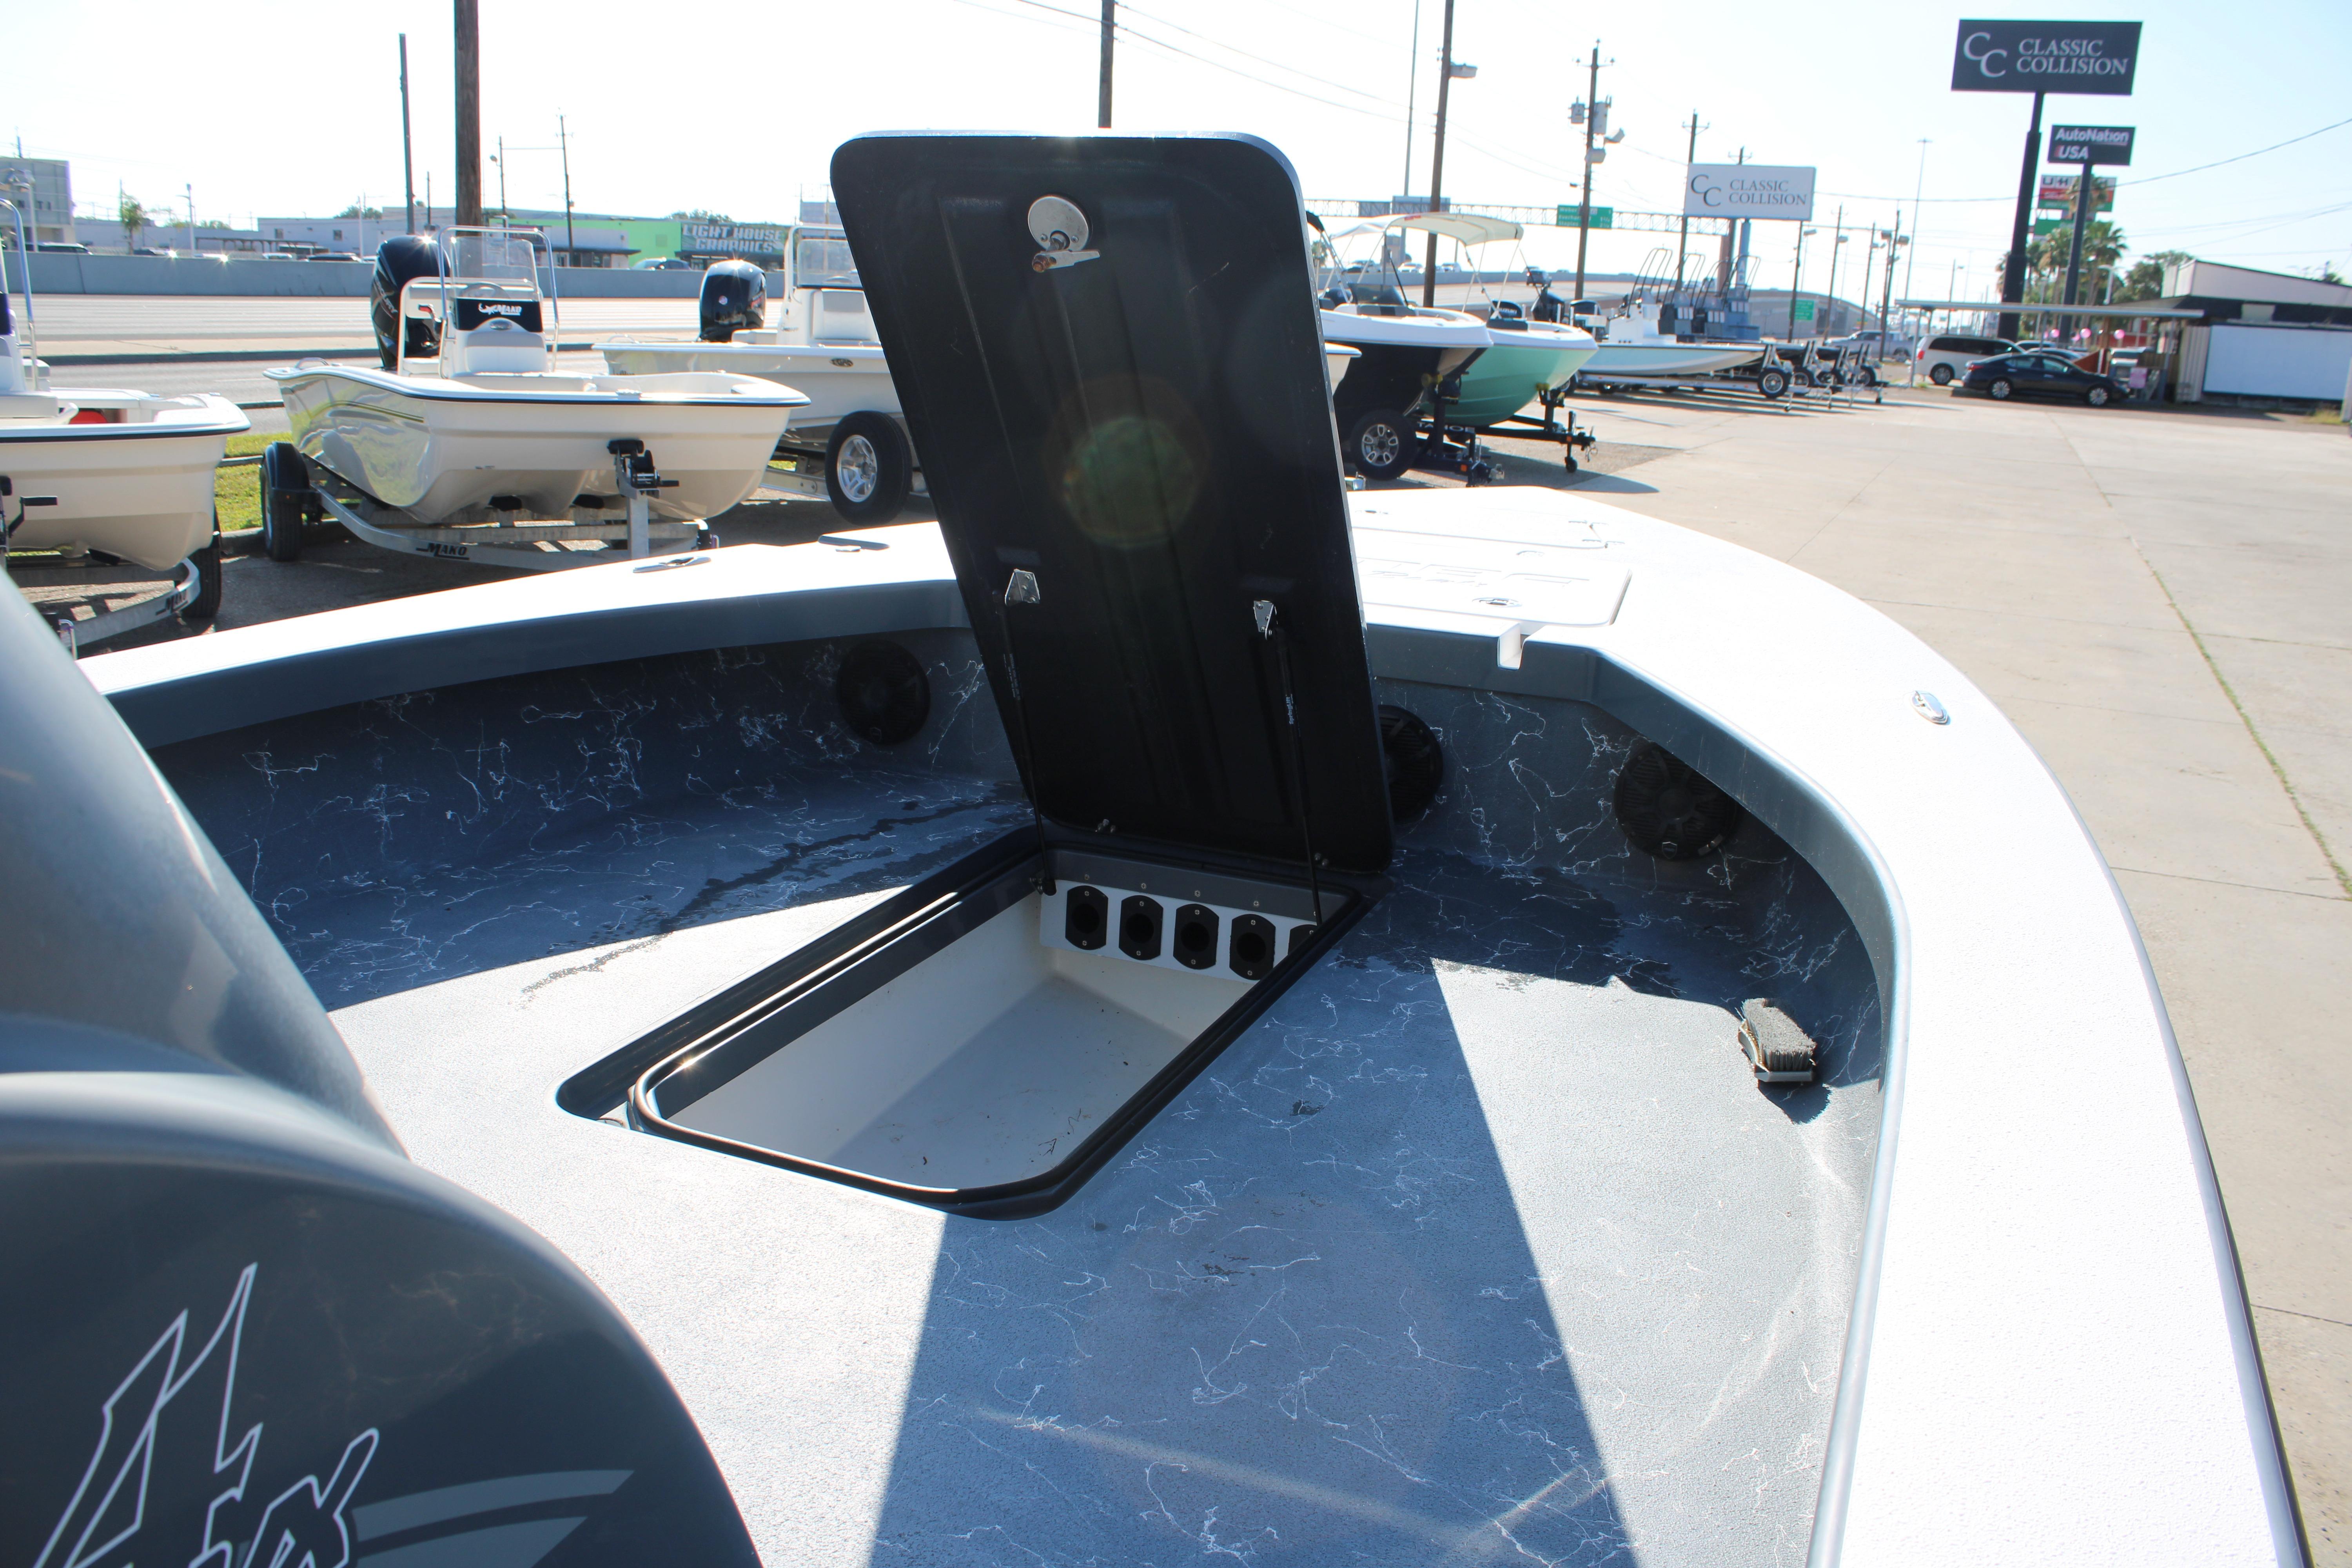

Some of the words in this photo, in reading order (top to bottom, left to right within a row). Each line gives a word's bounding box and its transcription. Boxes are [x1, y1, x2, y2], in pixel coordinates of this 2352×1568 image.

[2018, 38, 2103, 57] CLASSIC
[2016, 56, 2129, 75] COLLISION
[2054, 127, 2129, 143] AutoNation
[2058, 145, 2089, 160] USA
[1730, 179, 1789, 192] CLASSIC
[1729, 192, 1807, 206] COLLISION
[682, 224, 731, 239] LIGHT
[733, 227, 784, 241] HOUSE
[695, 238, 773, 253] GRAPHICS
[495, 304, 522, 316] MAKO
[416, 543, 470, 560] MAKO
